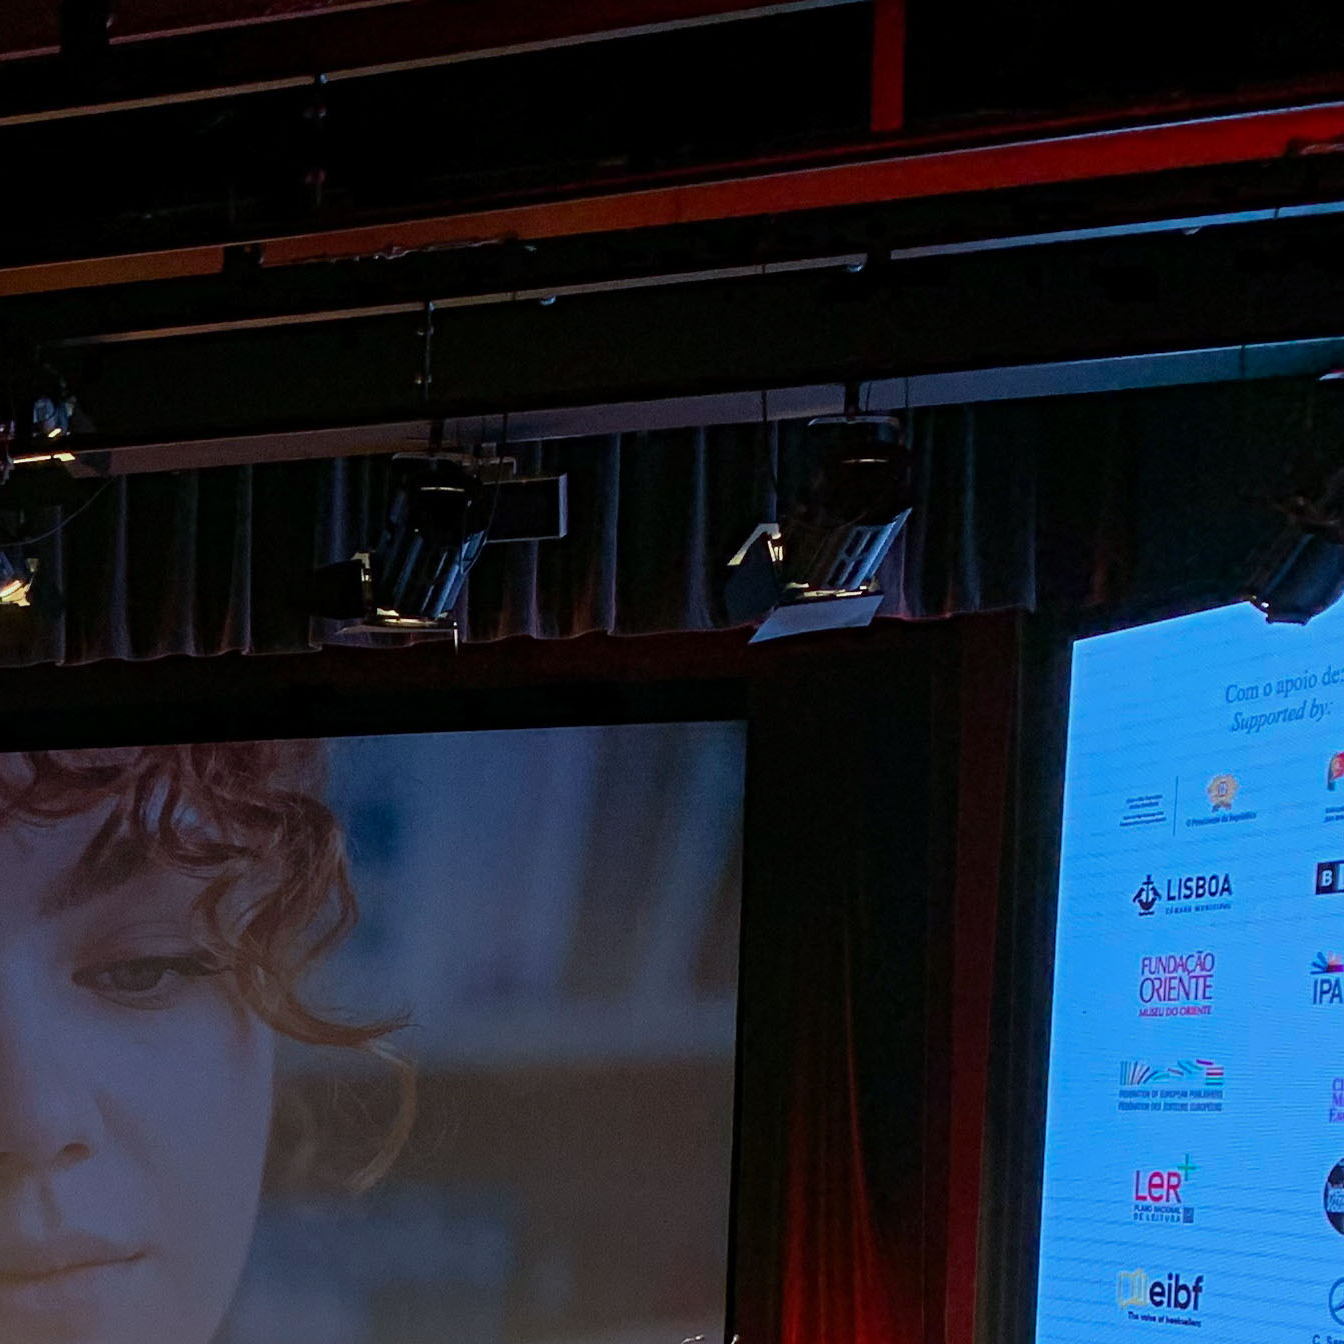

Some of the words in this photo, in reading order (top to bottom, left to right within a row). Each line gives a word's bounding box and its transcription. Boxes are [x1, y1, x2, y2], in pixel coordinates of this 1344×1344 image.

[1225, 684, 1259, 703] Com
[1263, 682, 1272, 697] o
[1276, 669, 1317, 698] apoio
[1231, 699, 1307, 734] Supported
[1310, 698, 1333, 722] by:
[1166, 873, 1233, 901] LISBOA
[1140, 950, 1215, 975] FUNDAÇÃO
[1139, 975, 1213, 1003] ORIENTE
[1149, 1273, 1204, 1311] eibf
